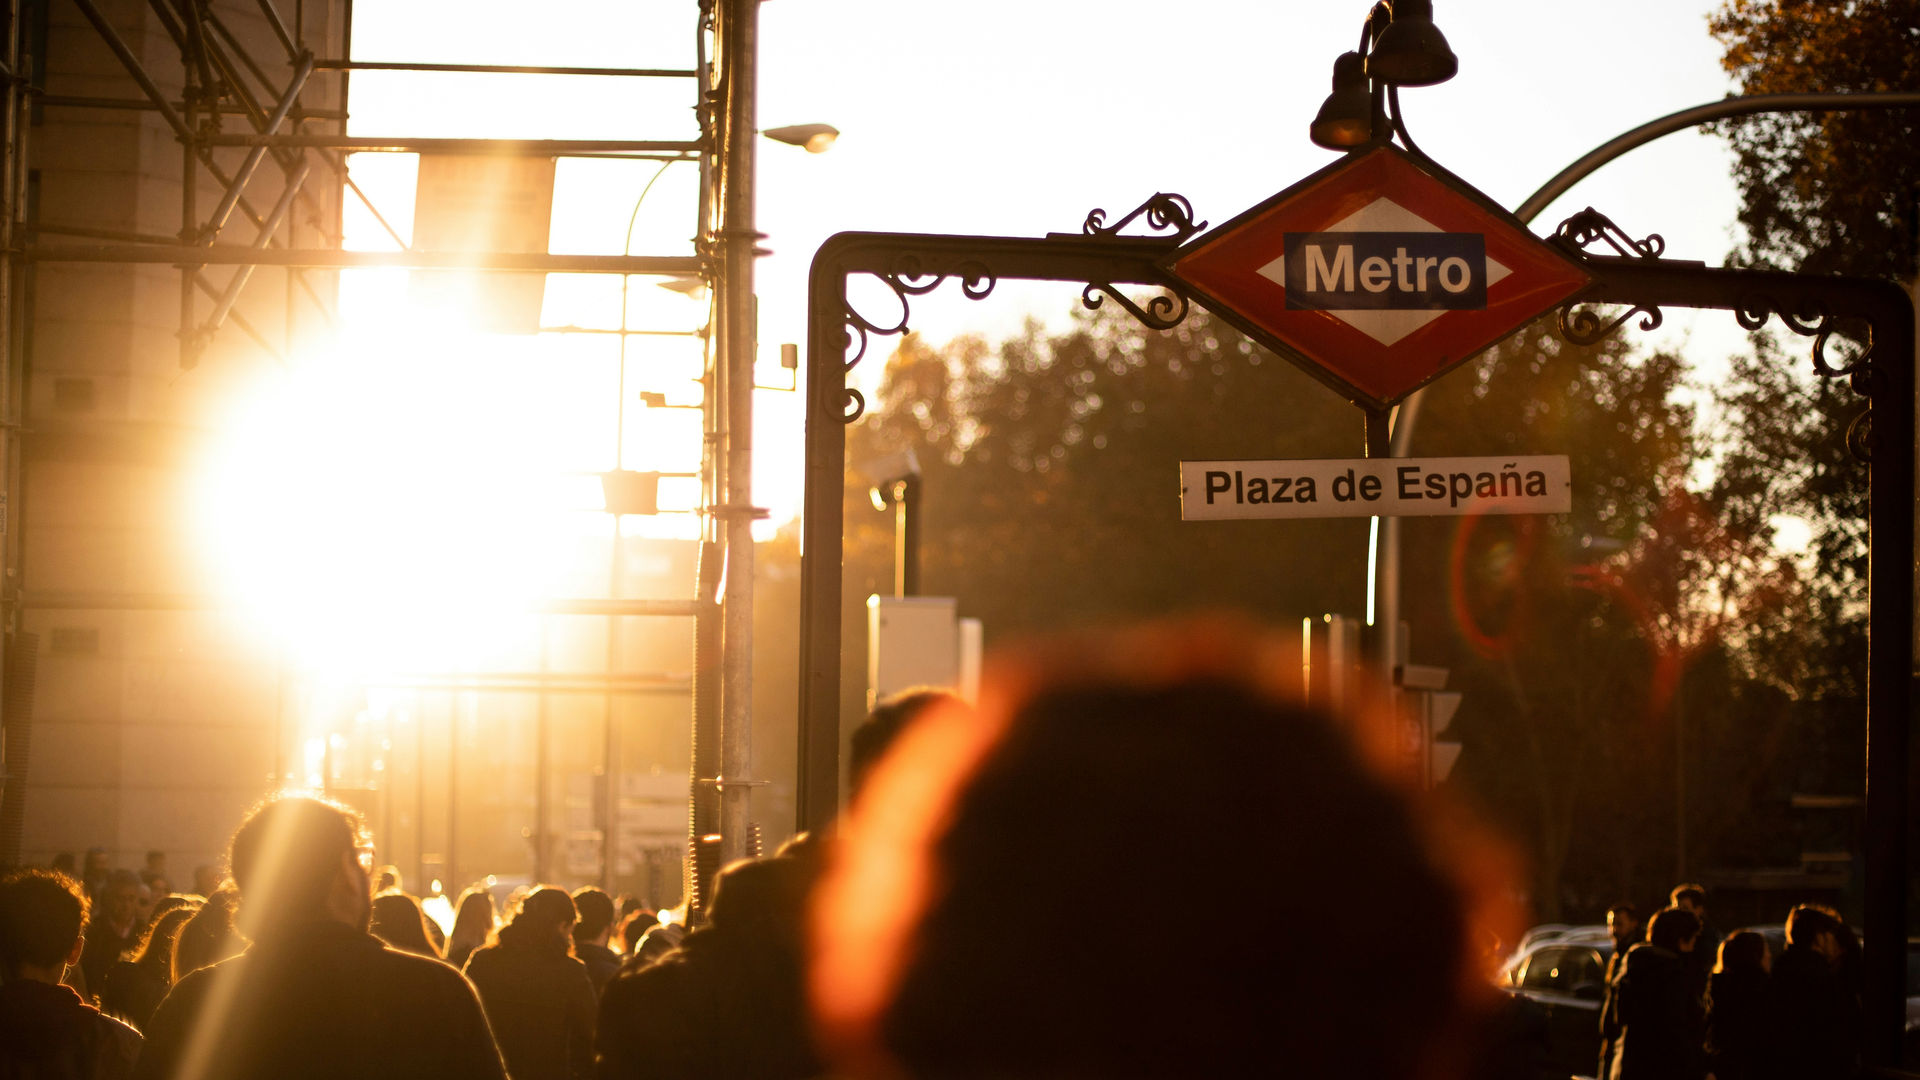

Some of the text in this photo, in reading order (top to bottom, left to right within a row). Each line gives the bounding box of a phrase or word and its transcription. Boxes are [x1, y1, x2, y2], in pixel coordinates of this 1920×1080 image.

[1304, 245, 1471, 293] Metro
[1205, 462, 1548, 509] Plaza de España
